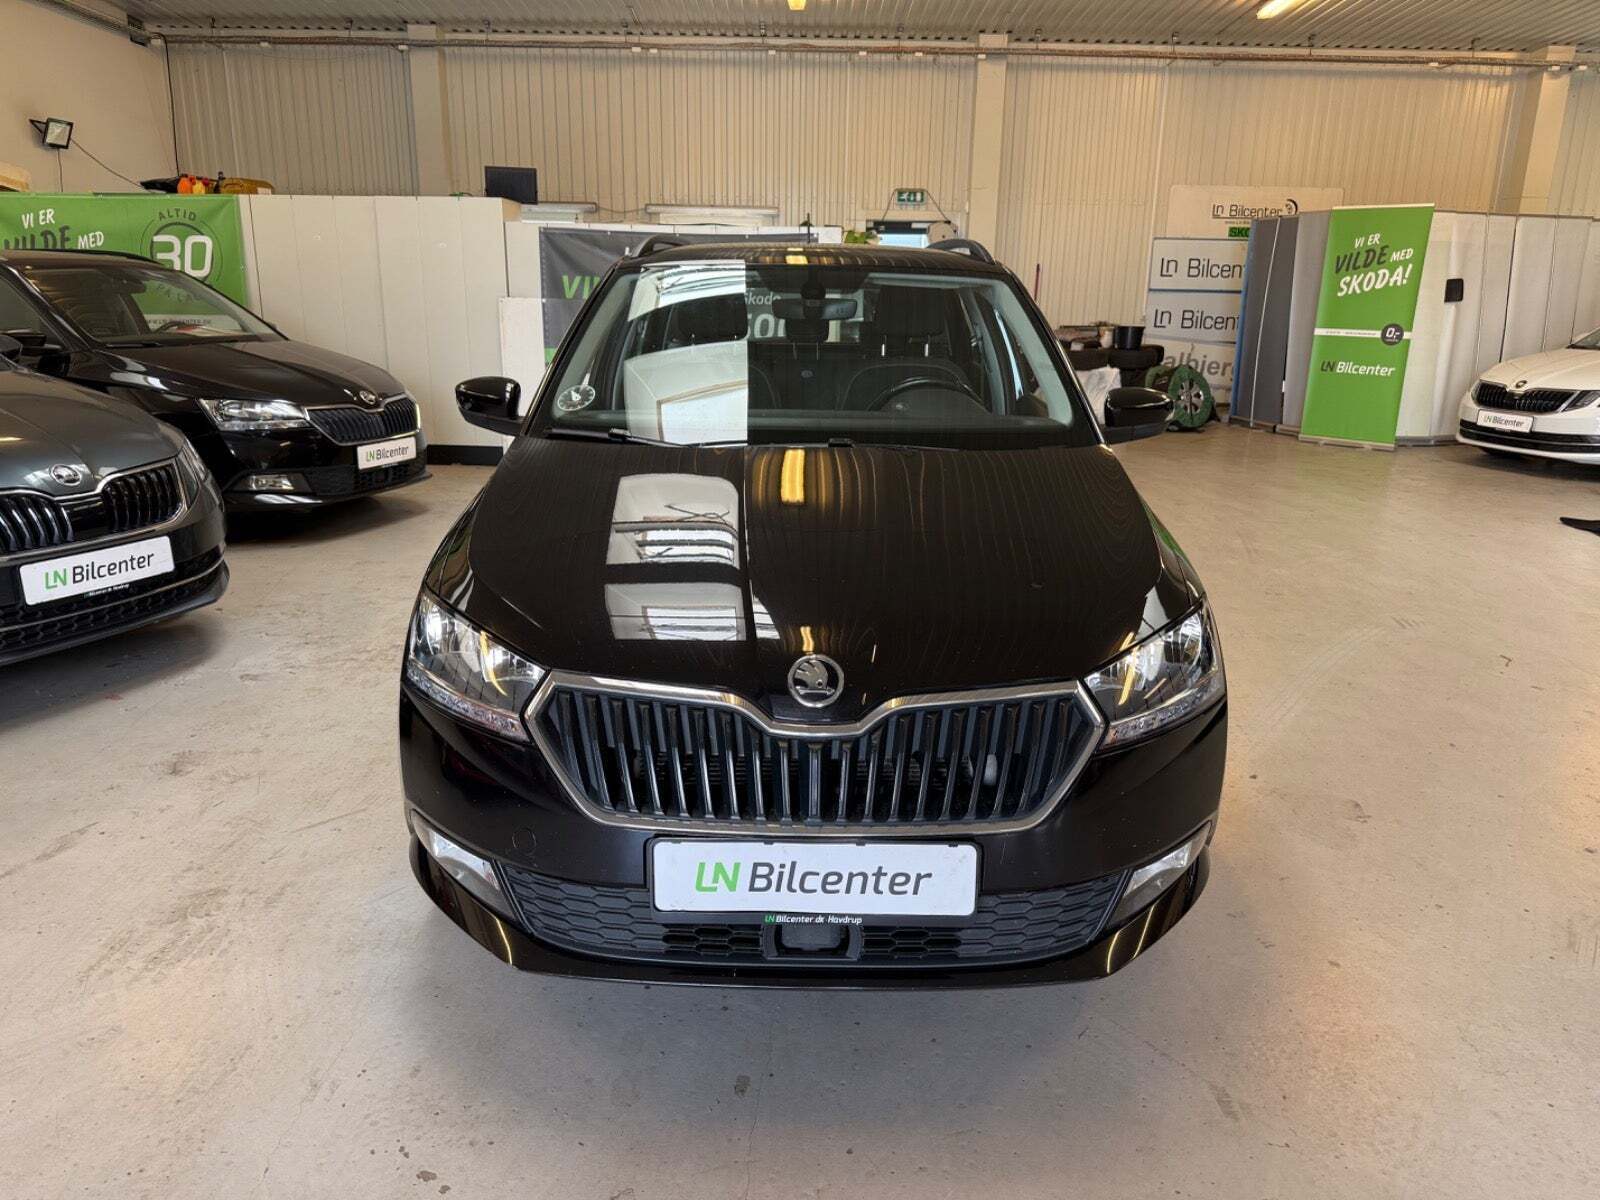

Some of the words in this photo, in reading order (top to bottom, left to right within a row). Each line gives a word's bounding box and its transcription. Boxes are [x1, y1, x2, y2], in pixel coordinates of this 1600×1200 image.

[22, 212, 34, 229] VI
[39, 208, 55, 225] ER
[158, 207, 197, 221] ALTID
[78, 231, 104, 249] MED
[1354, 236, 1365, 248] VI
[1367, 233, 1380, 246] ER
[153, 234, 213, 278] 30
[1335, 245, 1389, 274] VILDE
[1390, 248, 1413, 262] MED
[1187, 258, 1245, 279] Bilcen
[1337, 263, 1413, 297] SKODA!
[1321, 361, 1335, 372] LN
[1336, 361, 1395, 376] Bilcenter
[376, 446, 408, 460] Bilcenter
[45, 568, 67, 589] LN
[73, 553, 154, 584] Bilcenter
[695, 862, 741, 893] LN
[748, 861, 933, 895] Bilcenter
